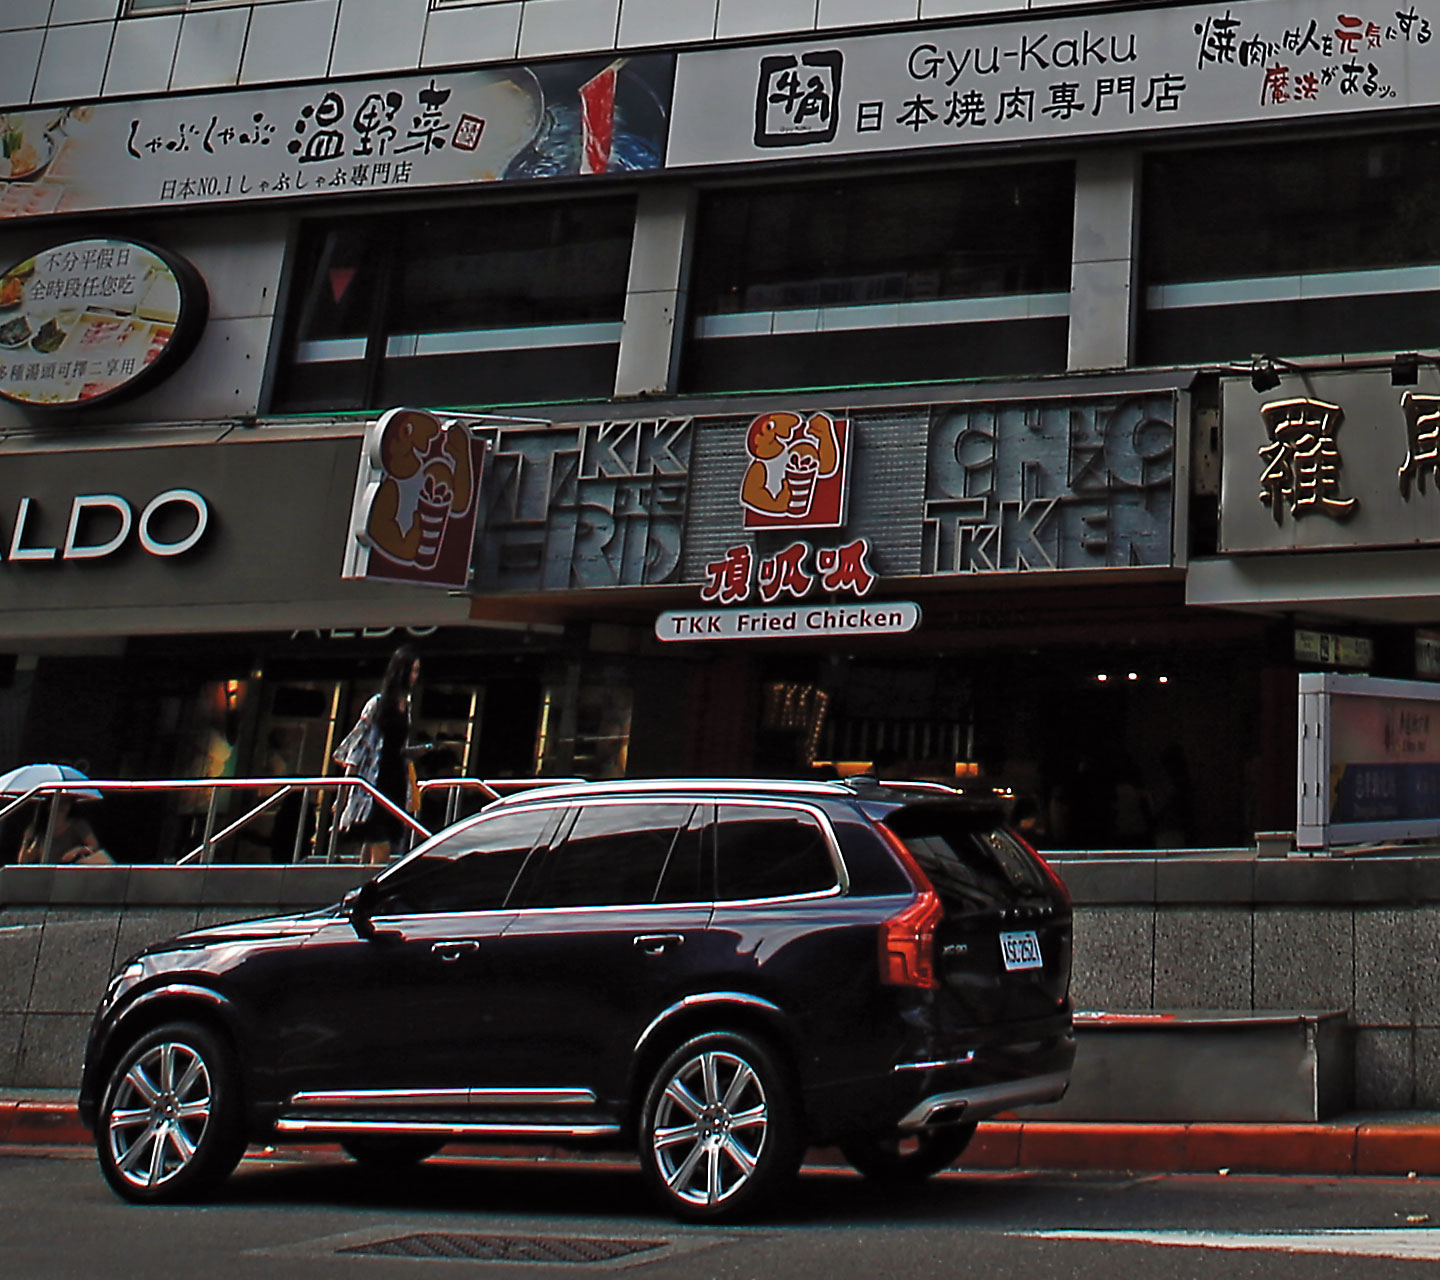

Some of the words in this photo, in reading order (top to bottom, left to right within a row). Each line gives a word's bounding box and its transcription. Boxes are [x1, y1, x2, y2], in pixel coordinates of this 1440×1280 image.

[907, 29, 1139, 89] Gyu-Kaku
[45, 247, 131, 273] 不分平假日
[30, 273, 138, 301] 全時段任您吃
[701, 539, 877, 606] 頂呱呱
[671, 615, 722, 635] TKK
[737, 610, 798, 631] Fried
[807, 606, 904, 630] Chicken
